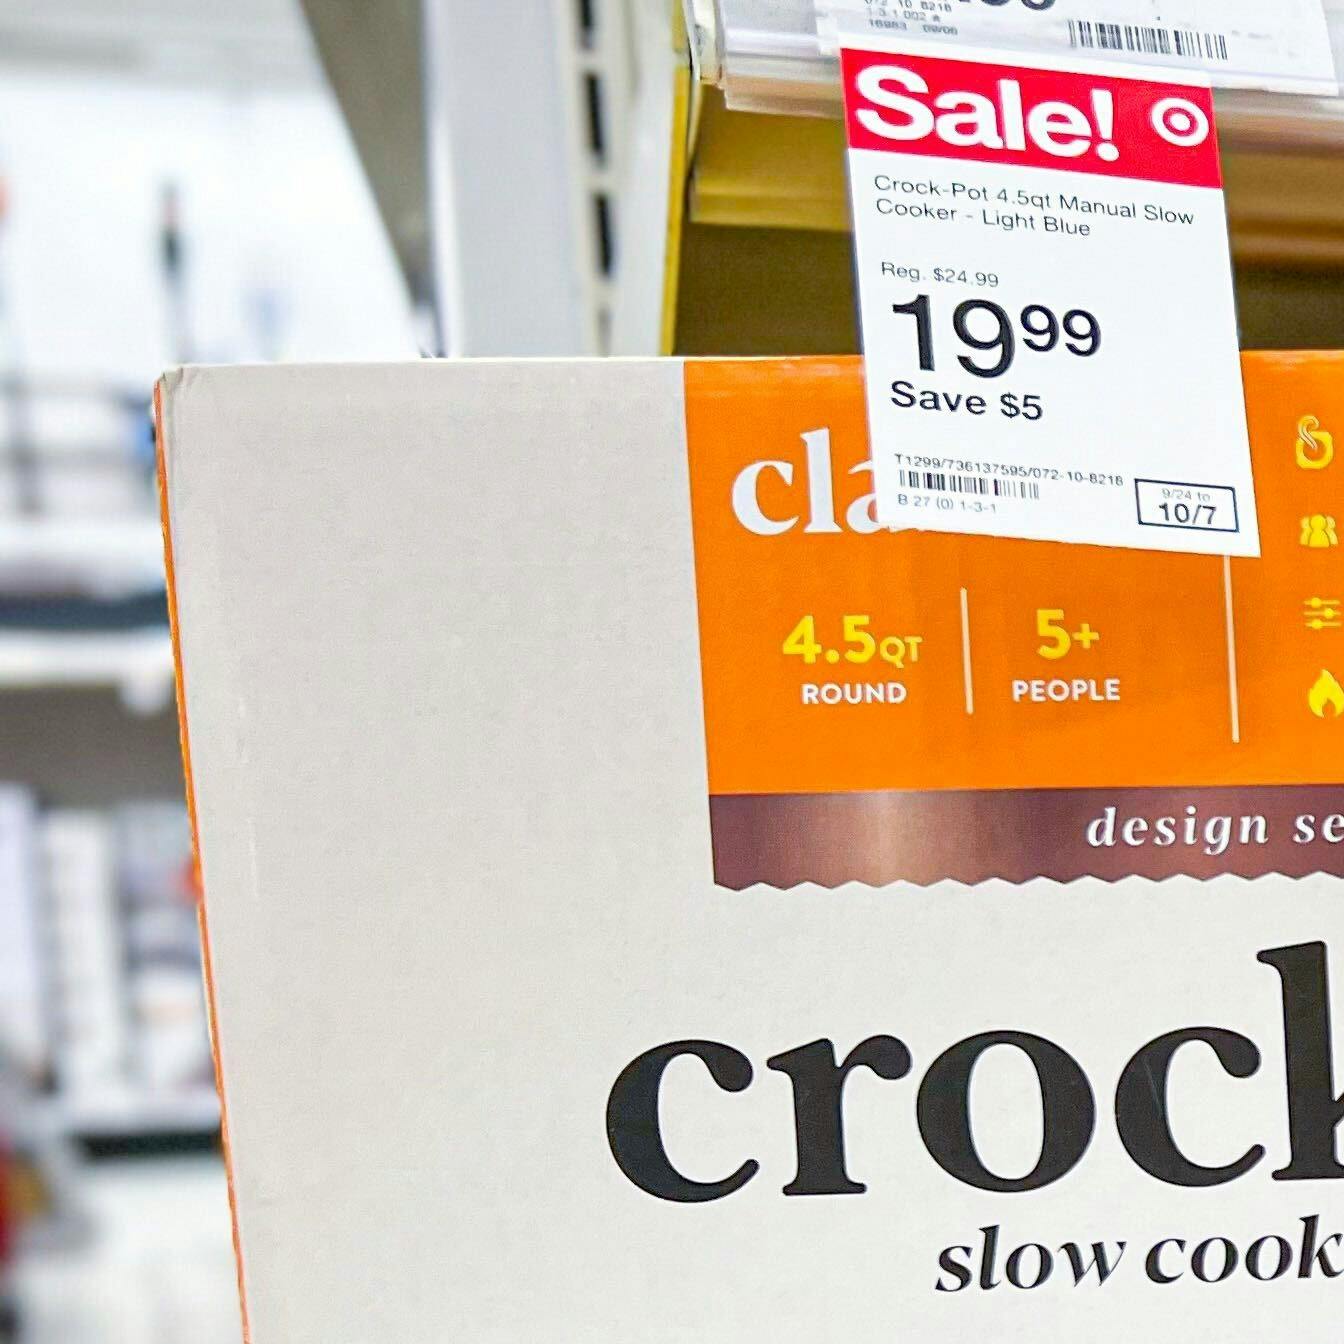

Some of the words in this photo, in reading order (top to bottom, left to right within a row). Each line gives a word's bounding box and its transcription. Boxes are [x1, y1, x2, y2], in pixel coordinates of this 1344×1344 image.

[854, 64, 1120, 162] Sale!
[874, 175, 988, 201] Crock-Pot
[996, 188, 1053, 209] 4.5qt
[1060, 194, 1136, 219] Manual
[1144, 205, 1194, 225] Slow
[876, 198, 957, 221] Cooker
[982, 209, 1035, 231] Light
[1044, 216, 1091, 236] Blue
[881, 262, 926, 282] Reg.
[933, 266, 999, 287] $24.99
[890, 380, 986, 417] Save
[999, 391, 1043, 421] $5
[913, 495, 931, 508] 27
[961, 500, 997, 513] 1-3-1
[1158, 502, 1217, 526] 10/7
[1162, 488, 1192, 501] 9/24
[782, 614, 922, 670] 4.5QT
[1034, 608, 1099, 660] 5+
[802, 682, 907, 704] ROUND
[1012, 677, 1120, 701] PEOPLE
[1085, 802, 1270, 860] design
[935, 1224, 1128, 1293] slow
